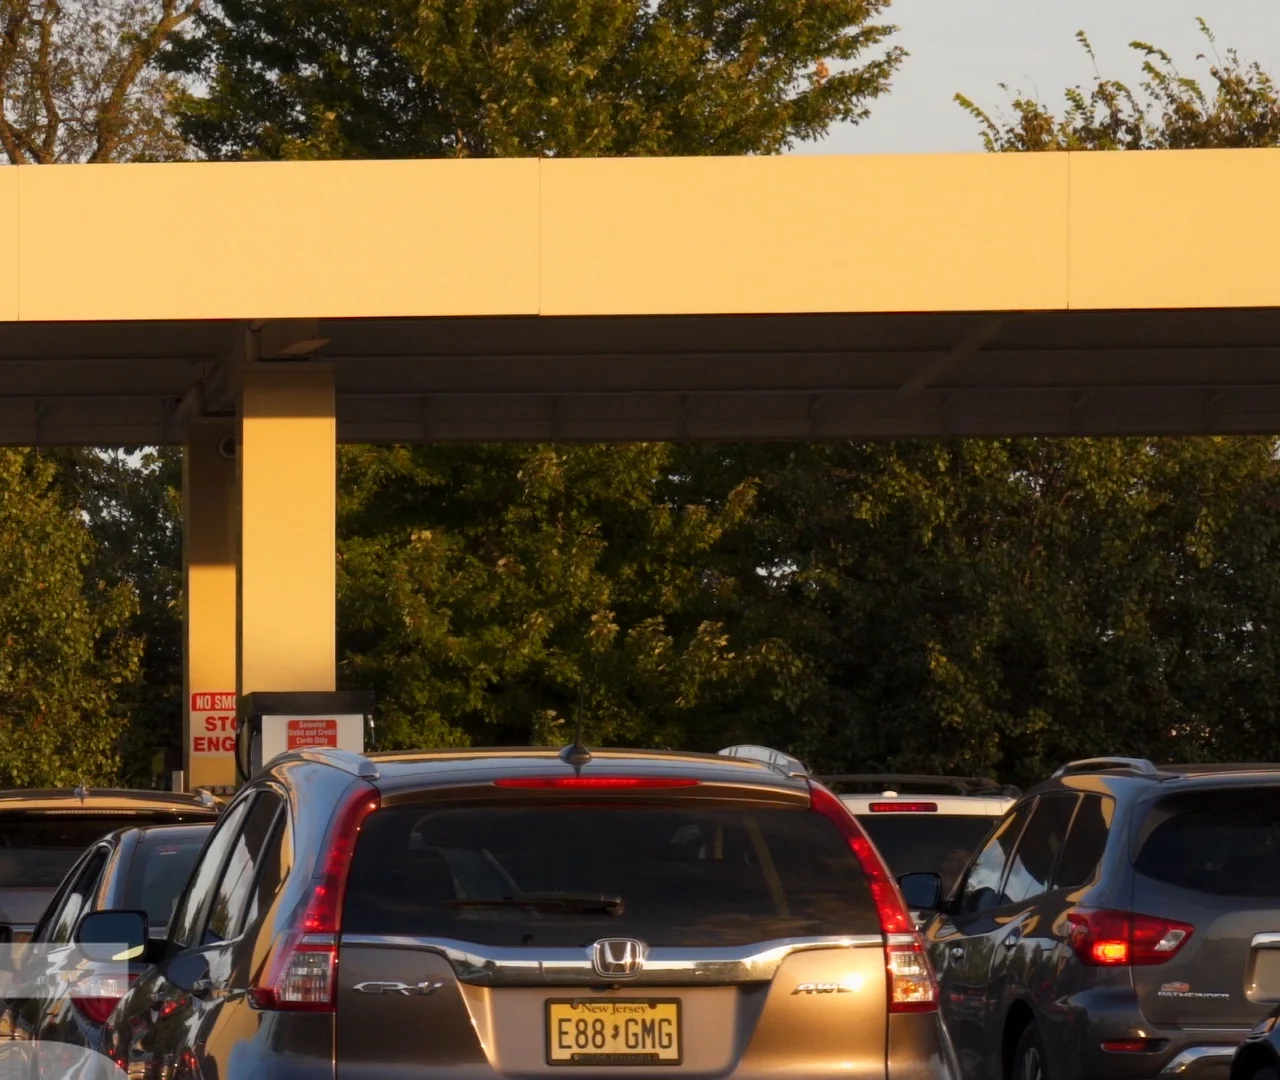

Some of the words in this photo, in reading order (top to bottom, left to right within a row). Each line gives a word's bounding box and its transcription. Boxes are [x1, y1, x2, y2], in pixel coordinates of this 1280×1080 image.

[196, 695, 211, 709] NO
[205, 716, 237, 732] ST
[193, 737, 236, 752] ENG
[352, 981, 443, 996] CR-V
[581, 1004, 609, 1013] New
[611, 1003, 648, 1015] Jersey
[557, 1018, 606, 1049] E88
[625, 1018, 673, 1049] GMG
